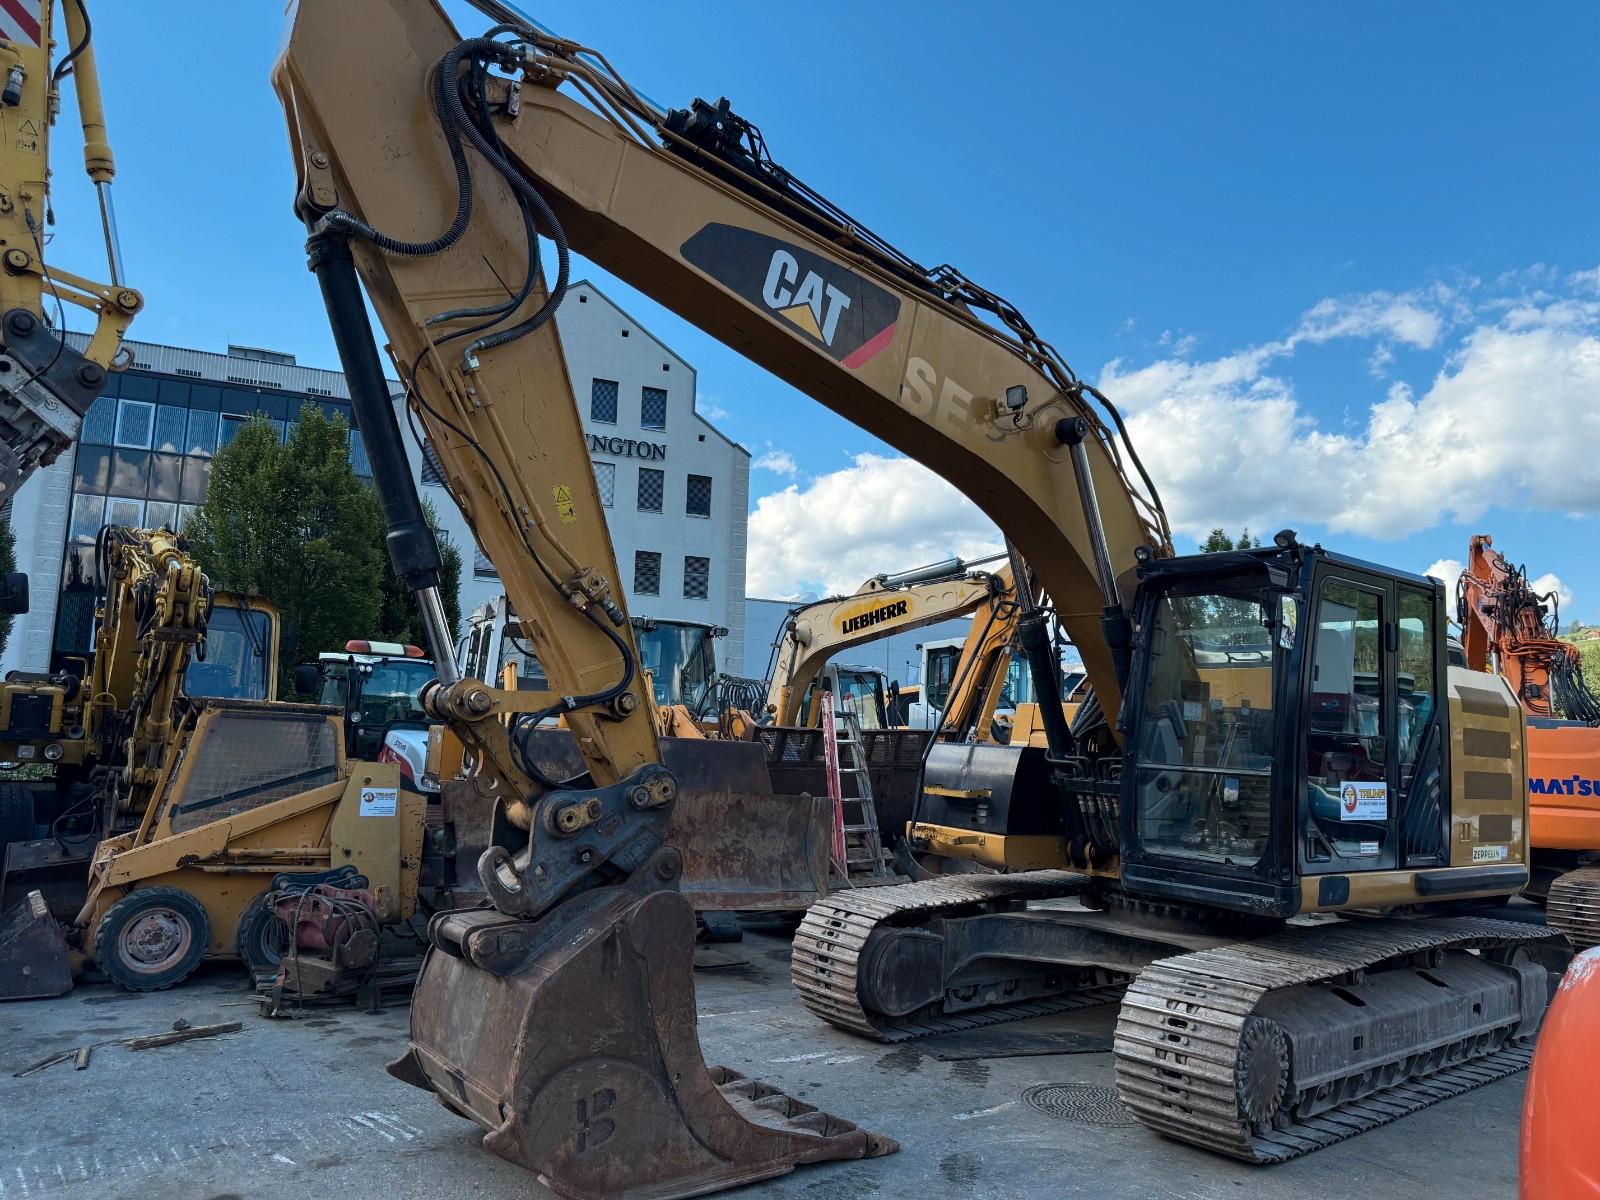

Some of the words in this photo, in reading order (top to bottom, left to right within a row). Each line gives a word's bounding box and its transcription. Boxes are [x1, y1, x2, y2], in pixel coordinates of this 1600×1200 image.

[762, 250, 851, 346] CAT
[842, 600, 908, 634] LIEBHERR
[1473, 849, 1500, 859] ZEPPELIN
